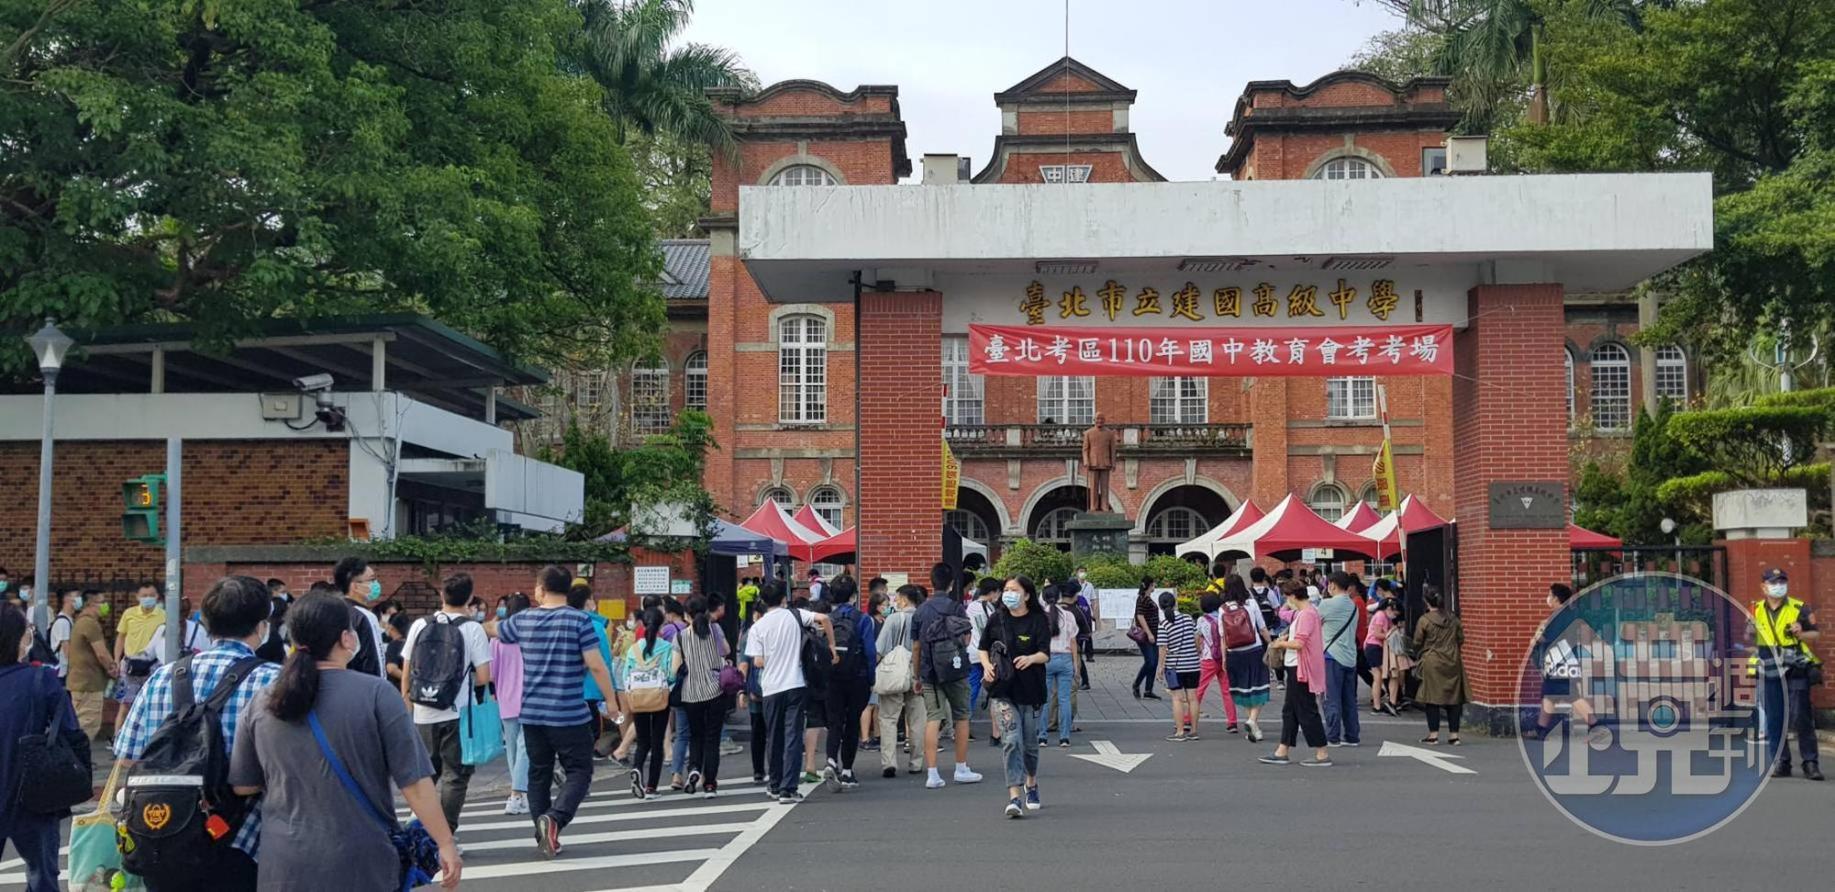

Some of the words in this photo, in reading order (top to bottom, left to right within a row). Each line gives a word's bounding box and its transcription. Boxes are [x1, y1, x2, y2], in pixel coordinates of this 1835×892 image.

[1018, 278, 1400, 324] 臺北市立建國高級中學
[984, 333, 1439, 365] 臺北考區110年國中教育會考考場
